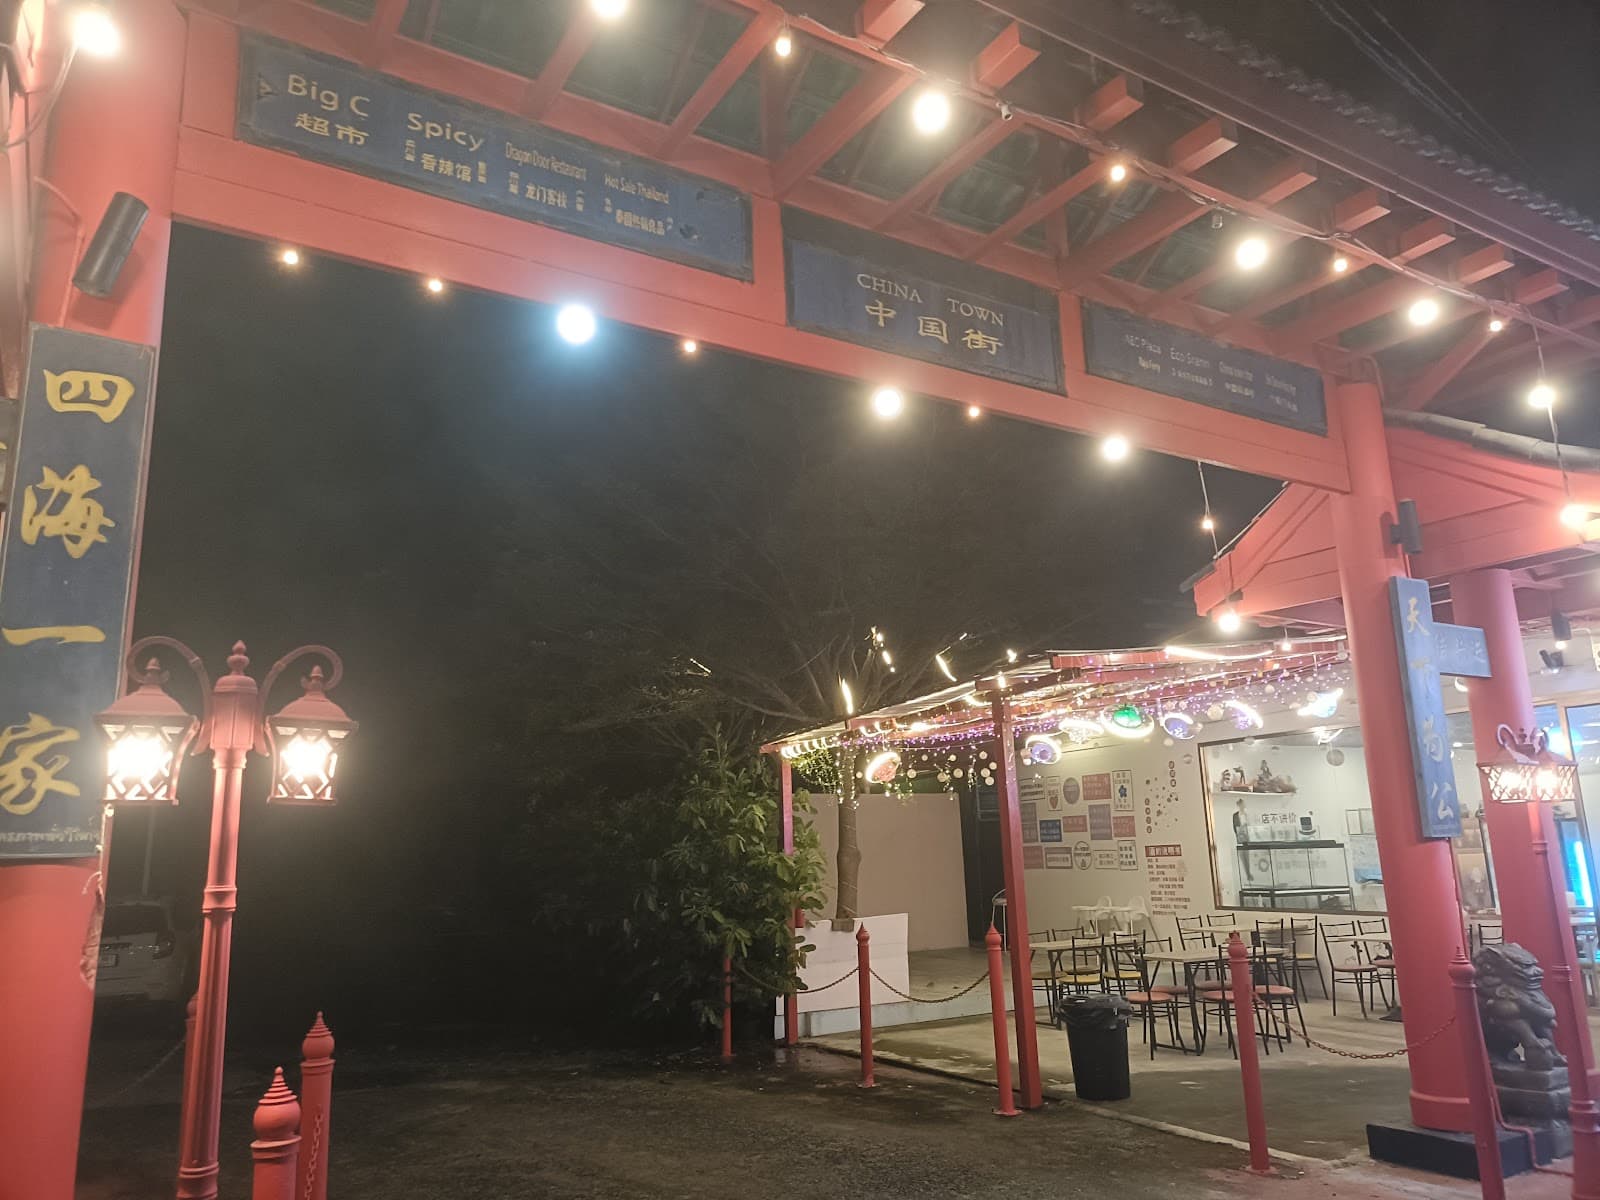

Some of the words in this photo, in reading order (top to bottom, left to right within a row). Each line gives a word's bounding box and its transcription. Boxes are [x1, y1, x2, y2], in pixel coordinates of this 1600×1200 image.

[287, 74, 338, 111] Big
[350, 95, 370, 118] C
[295, 113, 369, 146] 超市
[407, 112, 484, 152] Spicy
[420, 153, 472, 183] 香辣馆
[505, 141, 532, 167] Dragon
[532, 149, 550, 169] Door
[550, 156, 588, 182] Restaurant
[525, 182, 568, 209] 龙门客栈
[604, 173, 619, 191] Hot
[637, 182, 670, 205] Thailand
[857, 273, 923, 304] CHINA
[947, 298, 1004, 328] TOWN
[865, 299, 1003, 356] 中国街
[0, 369, 135, 816] 四海一家
